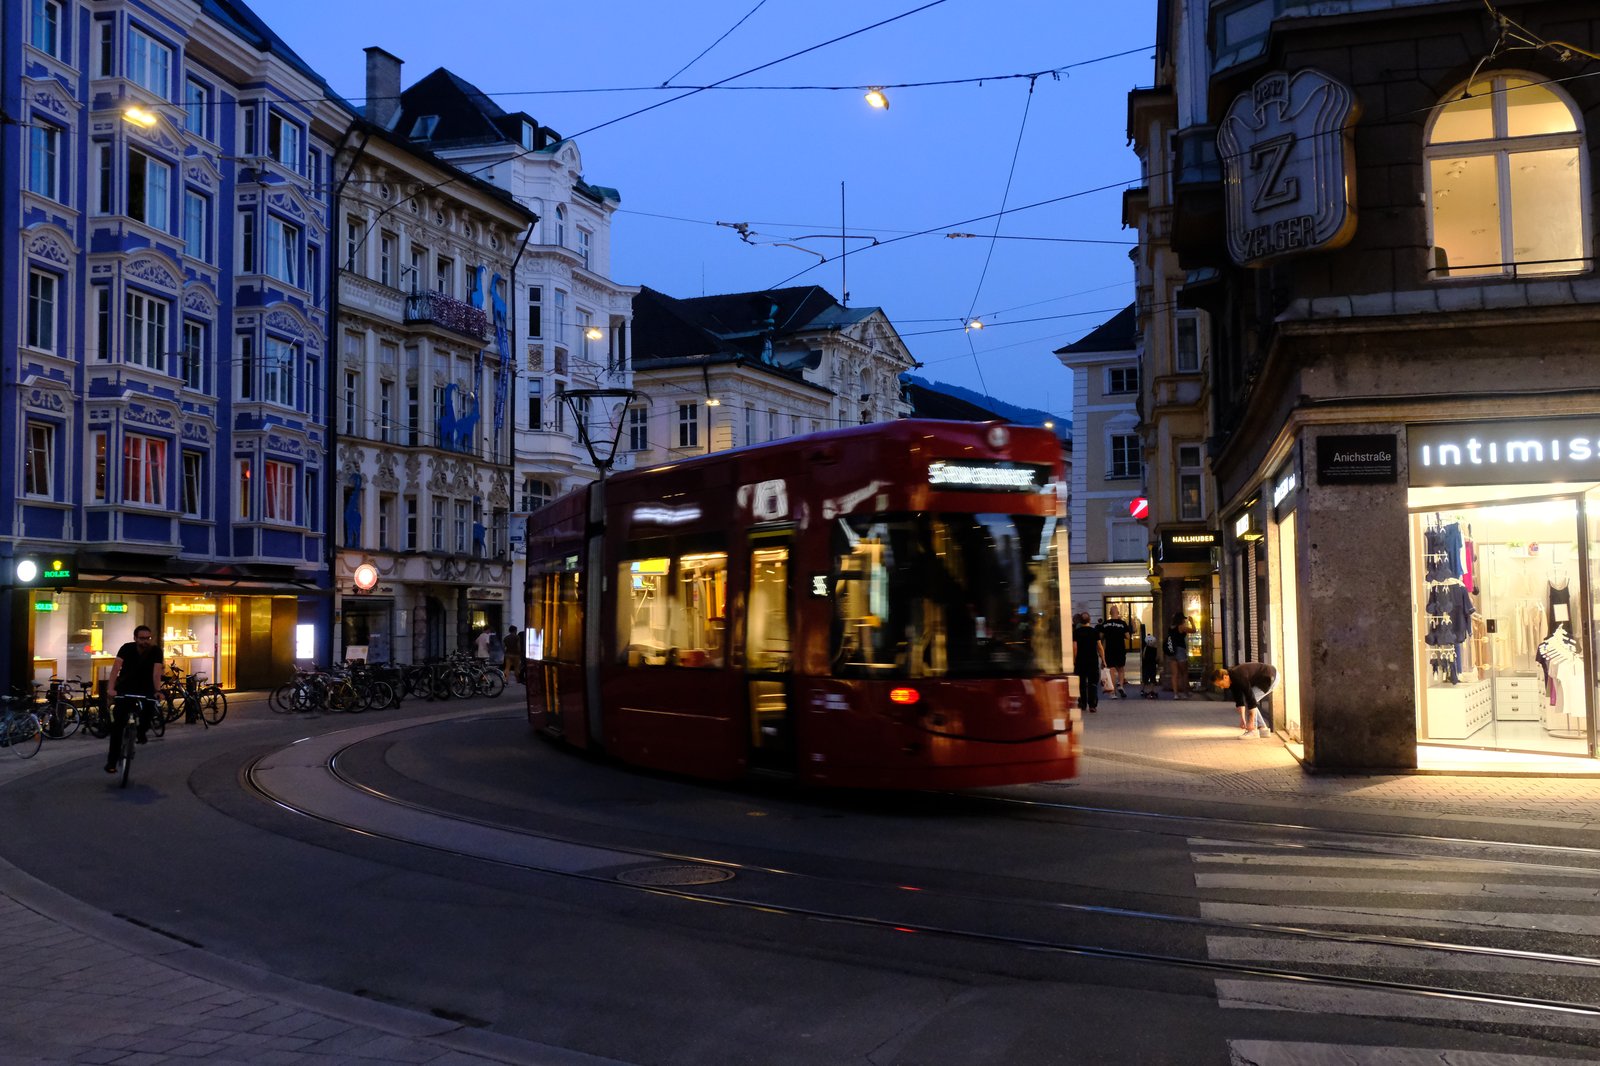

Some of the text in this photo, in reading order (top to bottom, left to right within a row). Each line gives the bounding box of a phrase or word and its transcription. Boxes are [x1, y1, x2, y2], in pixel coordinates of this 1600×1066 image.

[1249, 131, 1298, 213] Z
[1245, 214, 1316, 258] ZELGER
[1333, 451, 1392, 462] Anichstraße
[1422, 437, 1600, 467] intimis
[1172, 534, 1215, 543] HALLHUBER
[44, 570, 70, 578] ROLEX
